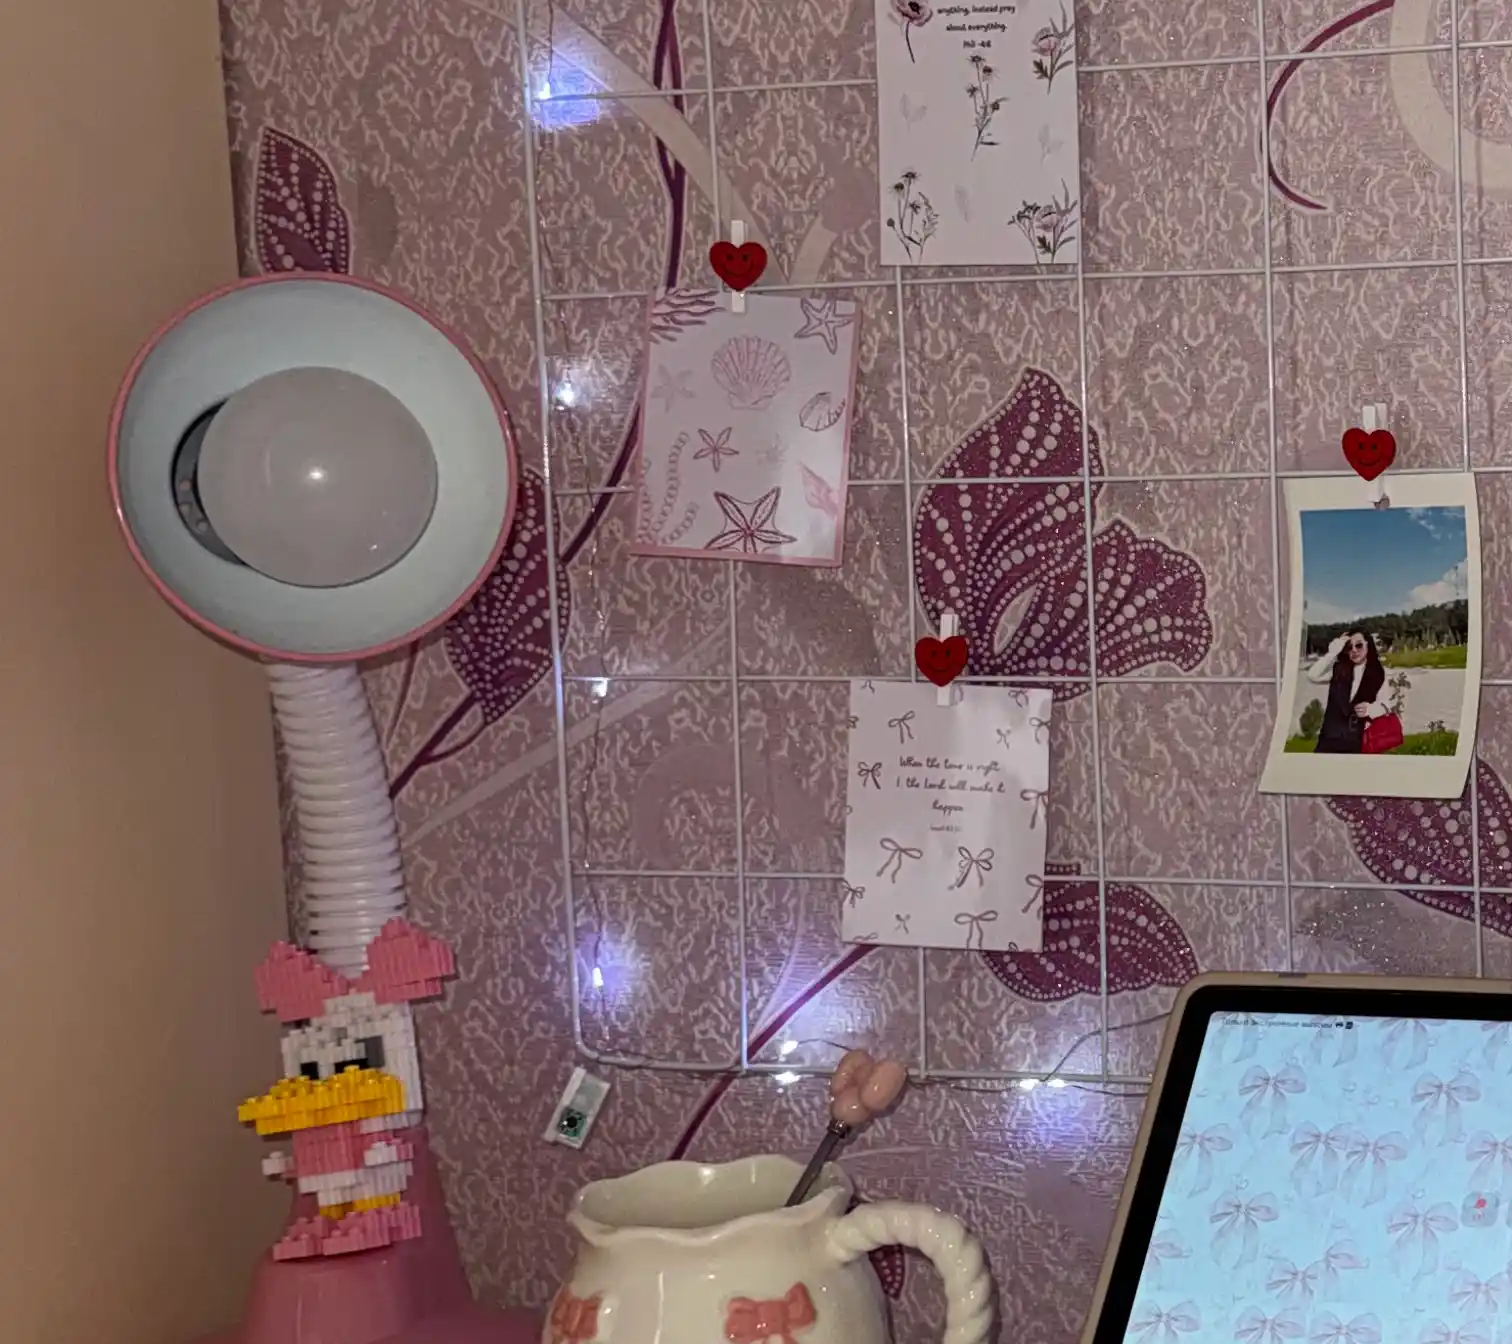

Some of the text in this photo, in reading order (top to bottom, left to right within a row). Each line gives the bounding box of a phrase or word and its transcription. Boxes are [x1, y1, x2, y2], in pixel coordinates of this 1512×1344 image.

[972, 4, 998, 12] instead
[1000, 6, 1015, 14] pray
[900, 756, 923, 767] When
[926, 757, 939, 768] the
[944, 758, 963, 770] time
[906, 777, 919, 788] the
[949, 780, 967, 790] will
[970, 782, 993, 792] make
[997, 781, 1005, 793] it
[932, 799, 963, 816] happen
